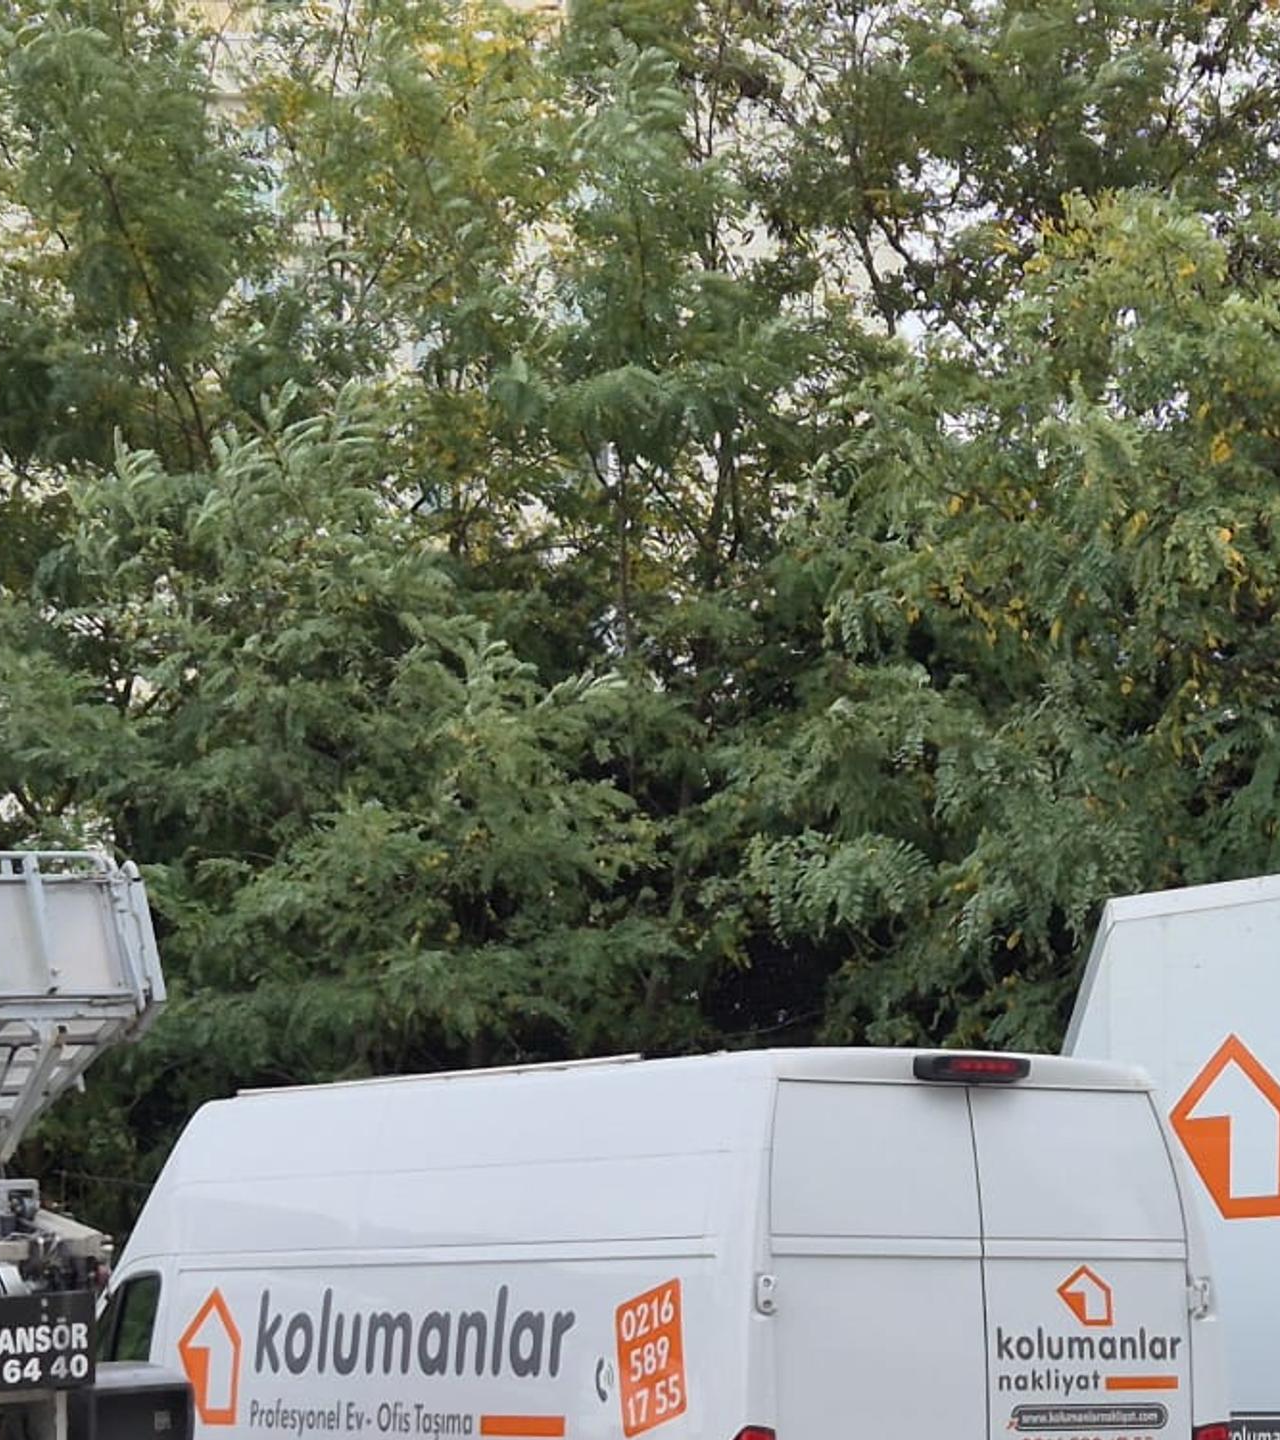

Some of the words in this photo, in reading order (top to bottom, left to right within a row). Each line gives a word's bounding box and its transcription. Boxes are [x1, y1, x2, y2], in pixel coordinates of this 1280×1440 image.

[254, 1284, 576, 1378] kolumanlar
[622, 1289, 674, 1342] 0216
[630, 1336, 669, 1382] 589
[997, 1326, 1182, 1360] kolumanlar
[3, 1358, 42, 1383] 64
[50, 1354, 88, 1379] 40
[998, 1369, 1100, 1396] nakliyat
[250, 1398, 340, 1437] Profesyonel
[346, 1402, 365, 1431] Ev
[376, 1402, 410, 1432] Ofis
[627, 1387, 649, 1427] 17
[655, 1374, 681, 1415] 55
